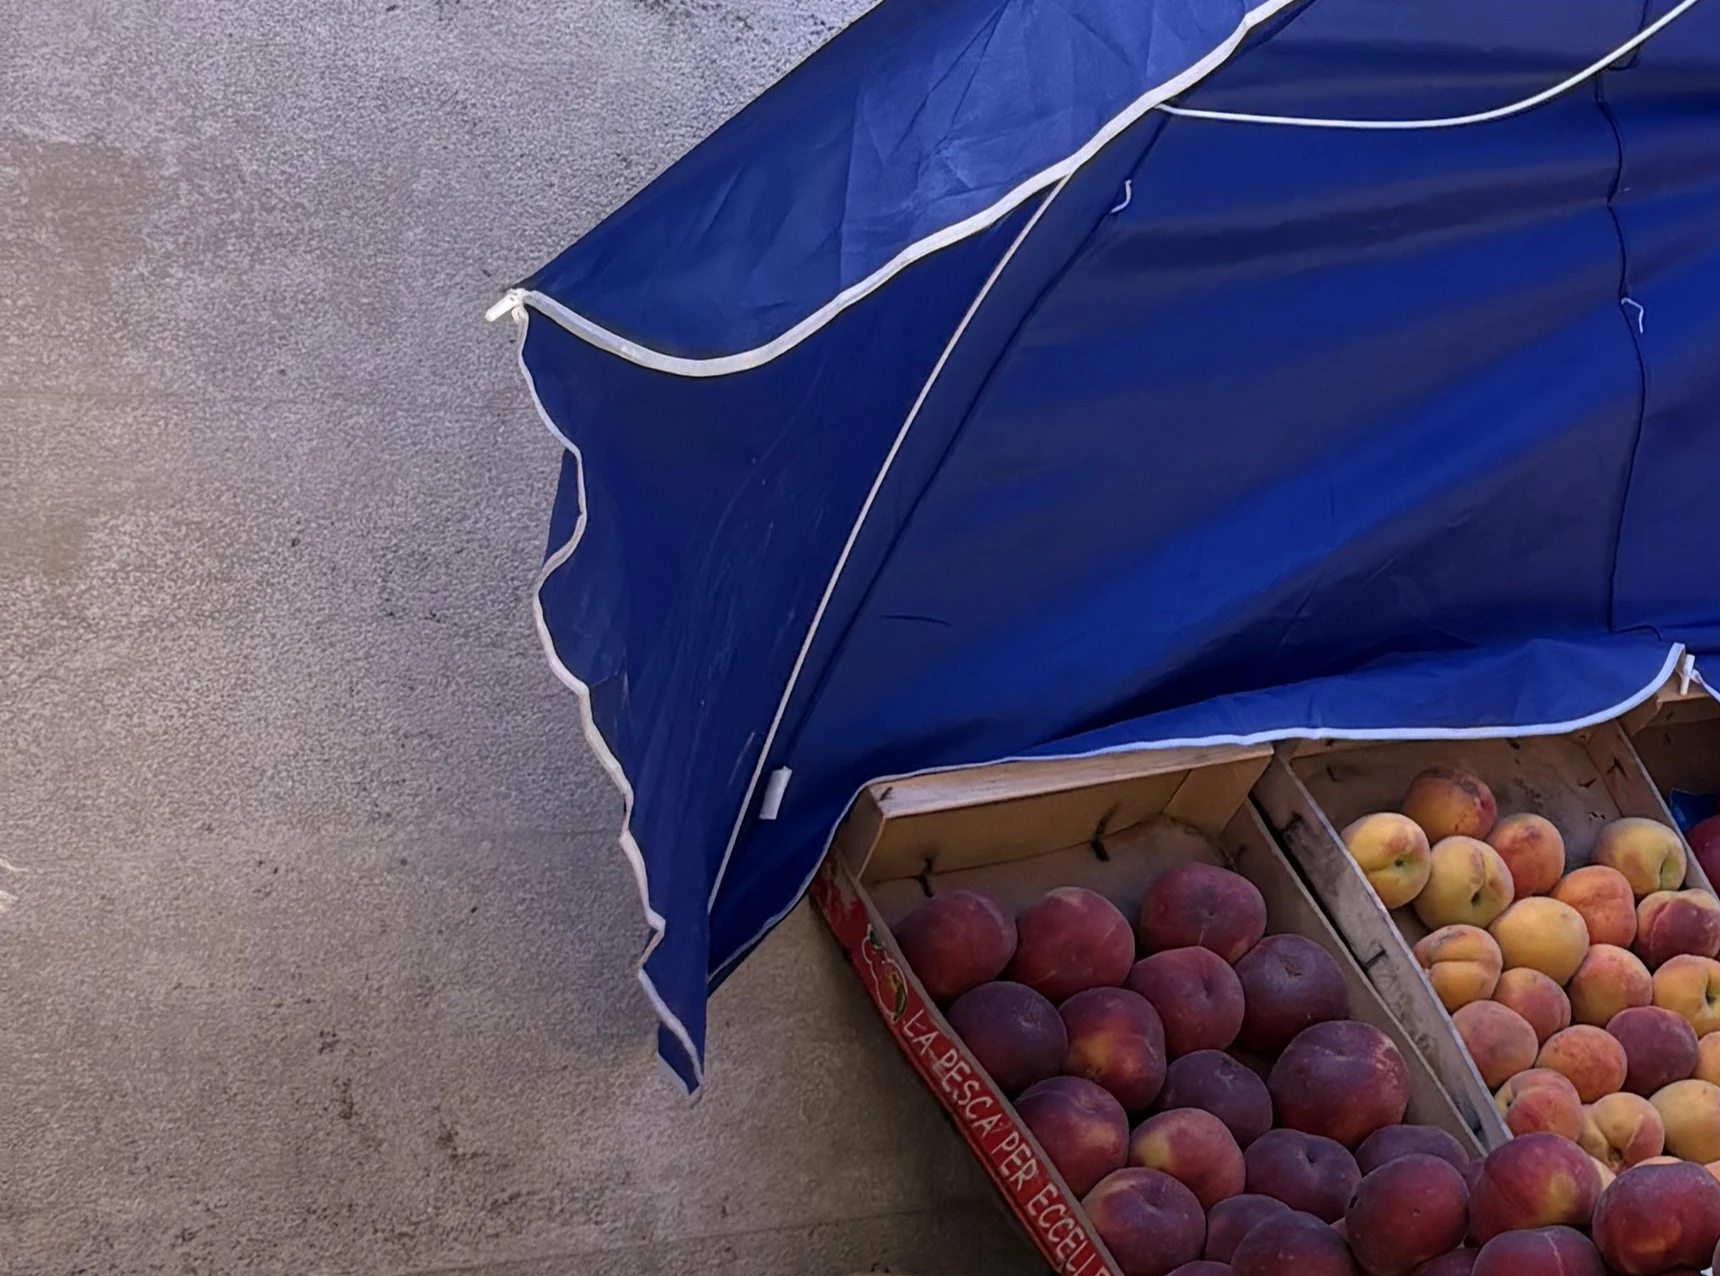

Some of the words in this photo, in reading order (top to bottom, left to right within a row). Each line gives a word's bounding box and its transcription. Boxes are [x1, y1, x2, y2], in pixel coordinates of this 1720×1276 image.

[903, 1009, 938, 1056] LA
[933, 1048, 1003, 1138] PESCA
[991, 1131, 1040, 1192] PER
